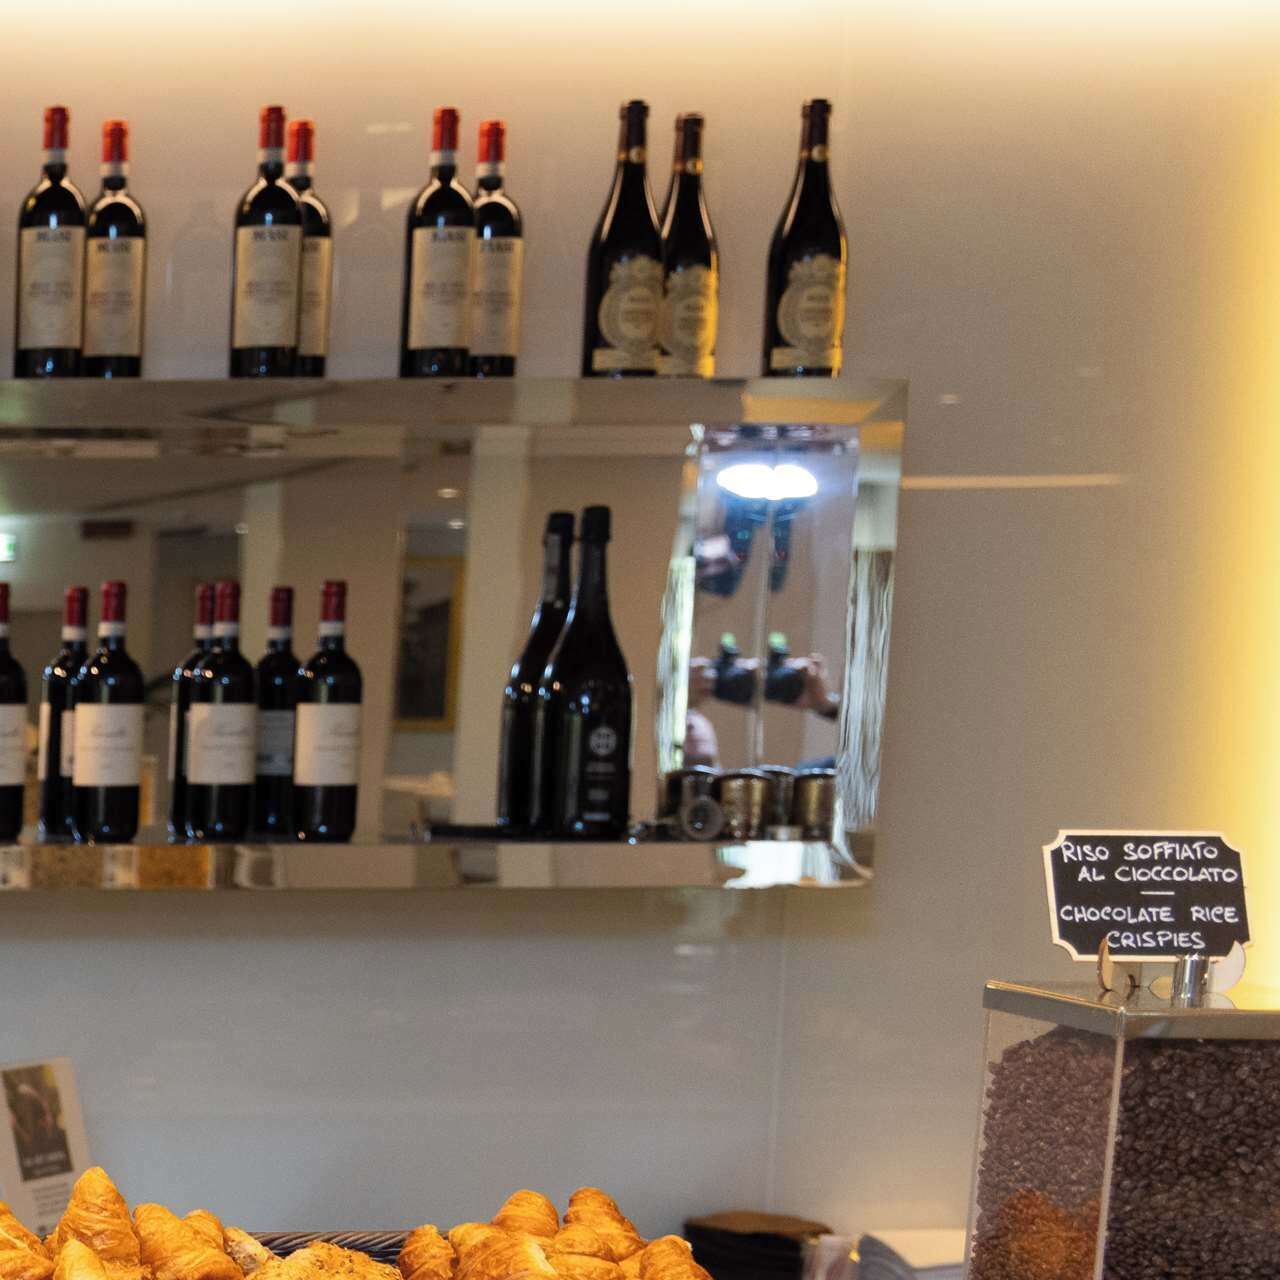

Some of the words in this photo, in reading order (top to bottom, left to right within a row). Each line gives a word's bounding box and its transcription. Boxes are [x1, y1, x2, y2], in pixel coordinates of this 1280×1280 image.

[1061, 842, 1110, 863] RISO
[1123, 841, 1218, 861] SOFFIATO
[1077, 866, 1105, 883] AL
[1114, 866, 1239, 883] CIOCCOLATO
[1059, 905, 1175, 924] CHOCOLATE
[1190, 906, 1240, 924] RICE
[1106, 931, 1206, 950] CRISPIES
